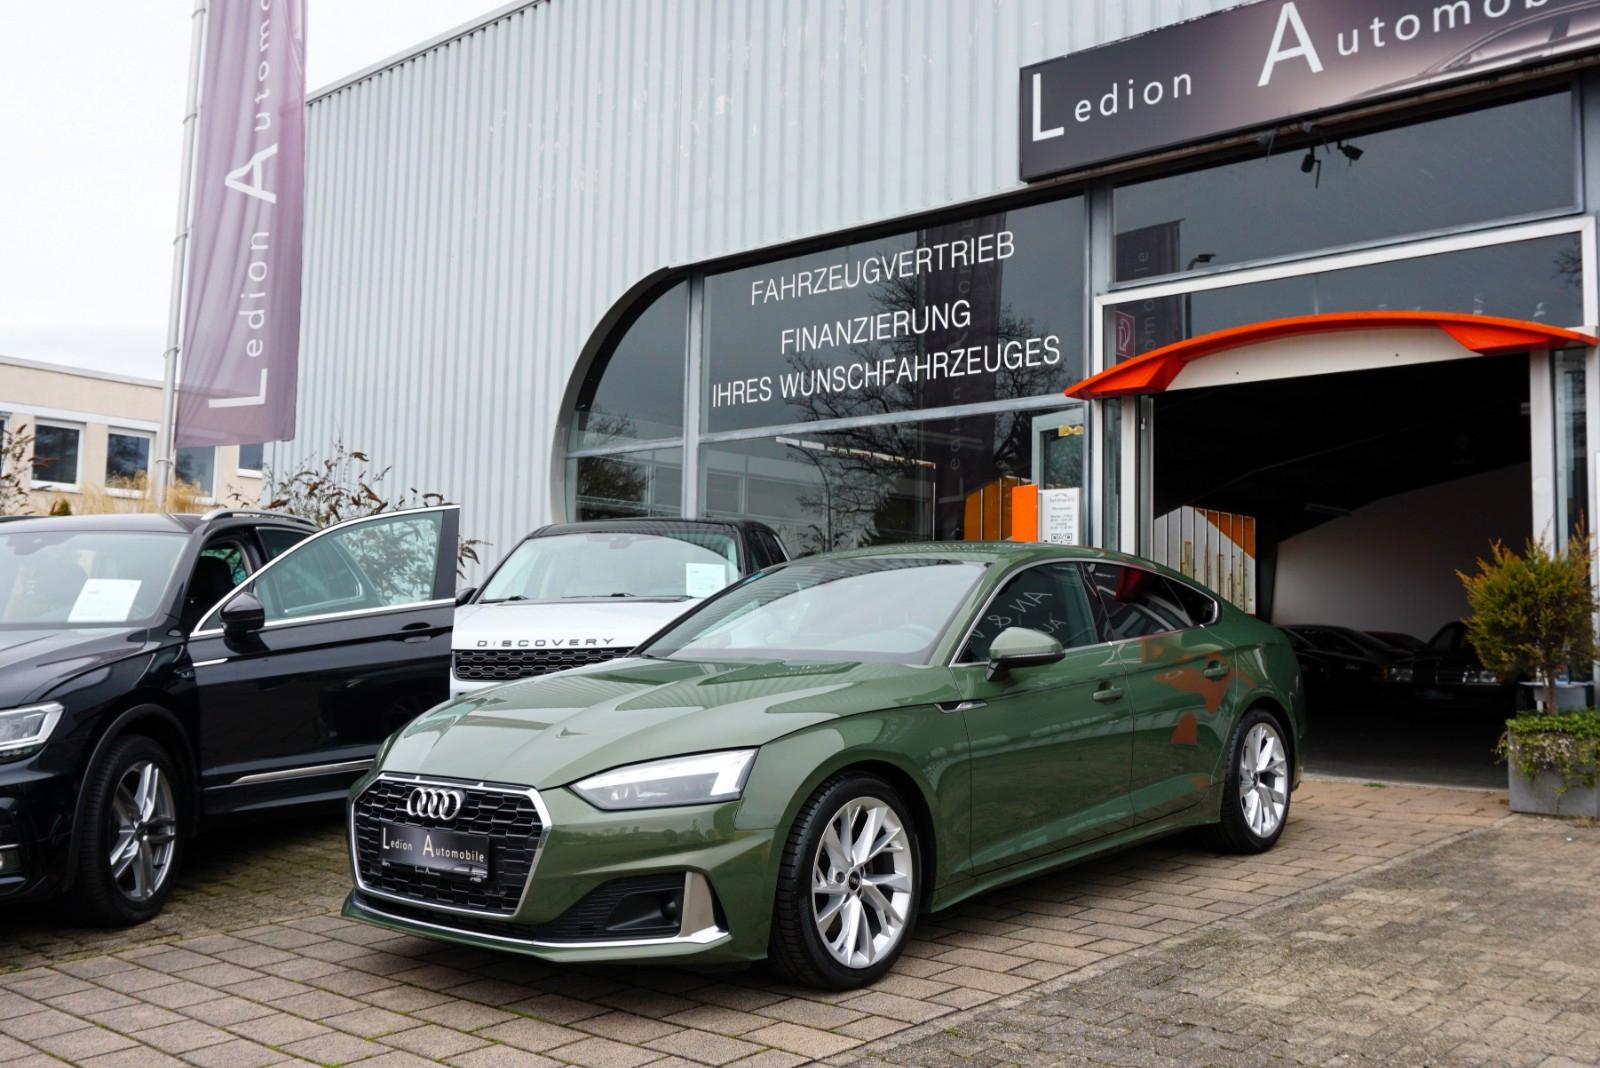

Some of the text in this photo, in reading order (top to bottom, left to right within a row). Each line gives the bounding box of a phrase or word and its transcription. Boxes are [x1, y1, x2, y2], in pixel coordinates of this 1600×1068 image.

[1032, 0, 1550, 143] Ledion Automo
[751, 230, 1016, 306] FAHRZEUGVERTRIEB
[208, 231, 270, 409] Ledion
[781, 299, 971, 355] FINANZIERUNG
[712, 335, 1061, 408] IHRES WUNSCHFAHRZEUGES
[477, 637, 615, 648] DISCOVERY
[382, 826, 485, 862] Ledion Automobile
